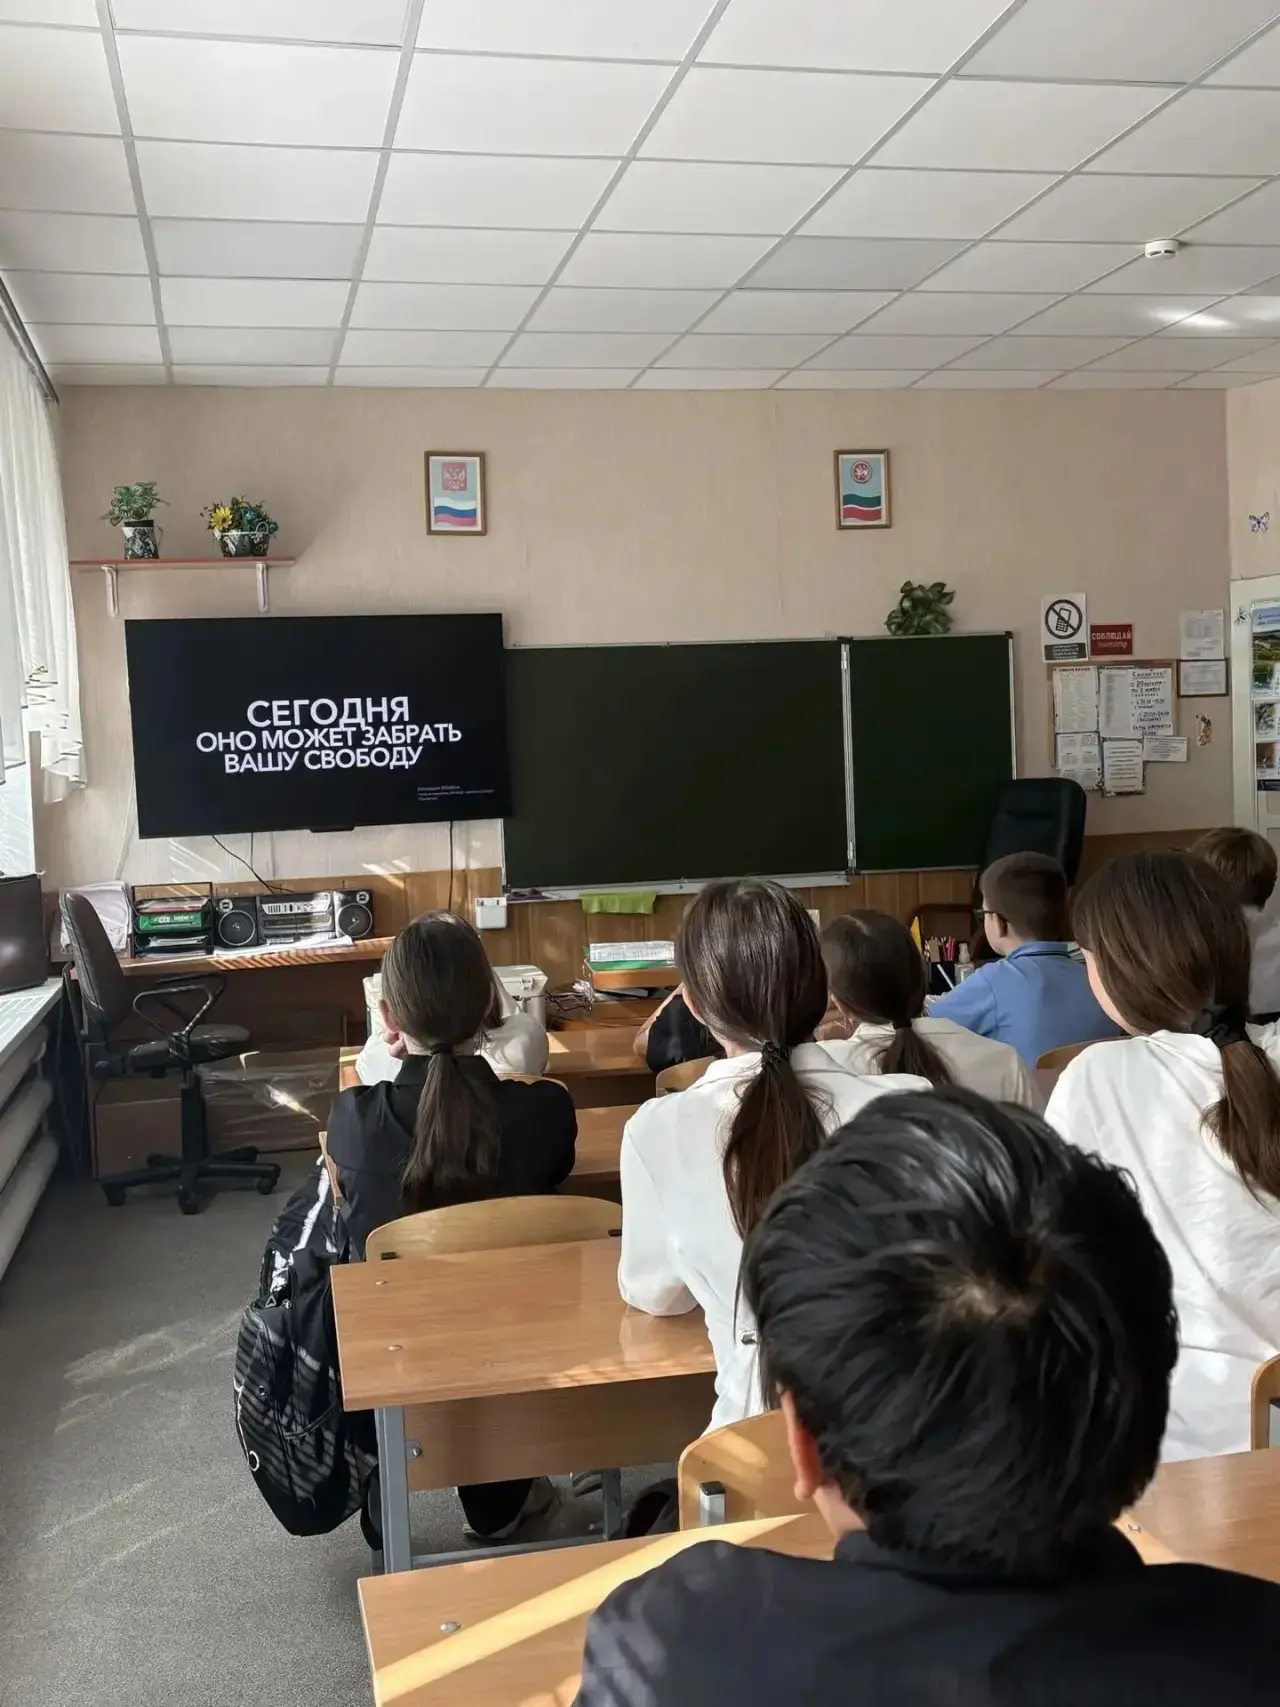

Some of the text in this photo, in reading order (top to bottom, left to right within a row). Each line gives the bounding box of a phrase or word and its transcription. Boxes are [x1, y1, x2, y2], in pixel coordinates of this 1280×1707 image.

[1091, 631, 1132, 641] СОБЛЮДАЙ
[247, 696, 409, 730] СЕГОДНЯ
[196, 723, 462, 752] ОНО МОЖЕТ ЗАБРАТЬ
[225, 746, 423, 774] ВАШУ СВОБОДУ
